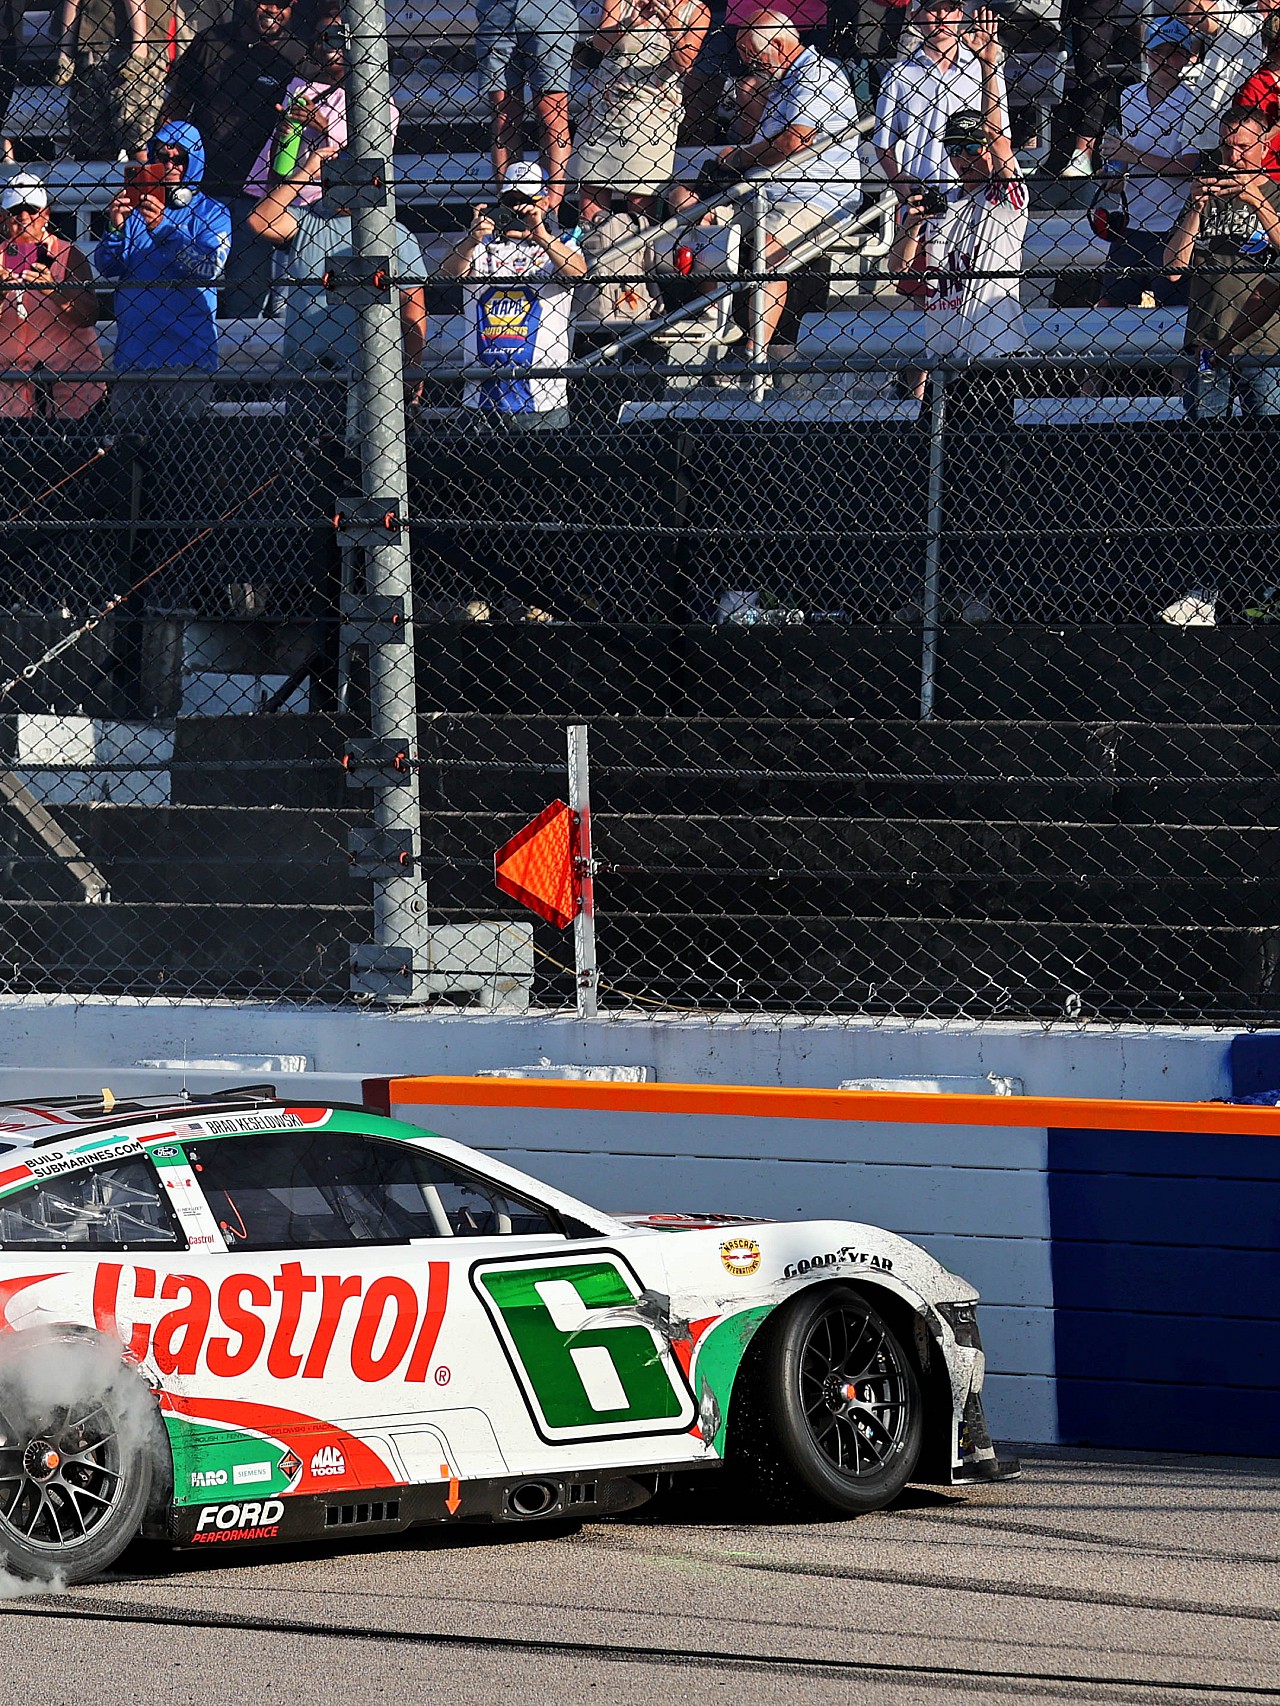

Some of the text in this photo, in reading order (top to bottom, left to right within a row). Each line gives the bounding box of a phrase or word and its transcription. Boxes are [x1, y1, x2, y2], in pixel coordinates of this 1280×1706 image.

[490, 298, 523, 316] NAPA
[207, 1114, 304, 1135] BRAD KESELOWSKI
[24, 1151, 64, 1169] BUILD
[33, 1141, 144, 1179] SUBMARINES.COM
[188, 1235, 215, 1245] Castrol
[723, 1239, 754, 1253] NASCAR
[93, 1261, 450, 1383] Castrol
[478, 1259, 685, 1430] 6
[311, 1446, 345, 1469] MAC
[237, 1468, 267, 1478] SIEMENS
[310, 1465, 346, 1477] TOOLS
[196, 1500, 285, 1532] FORD
[191, 1526, 280, 1543] PERFORMANCE
